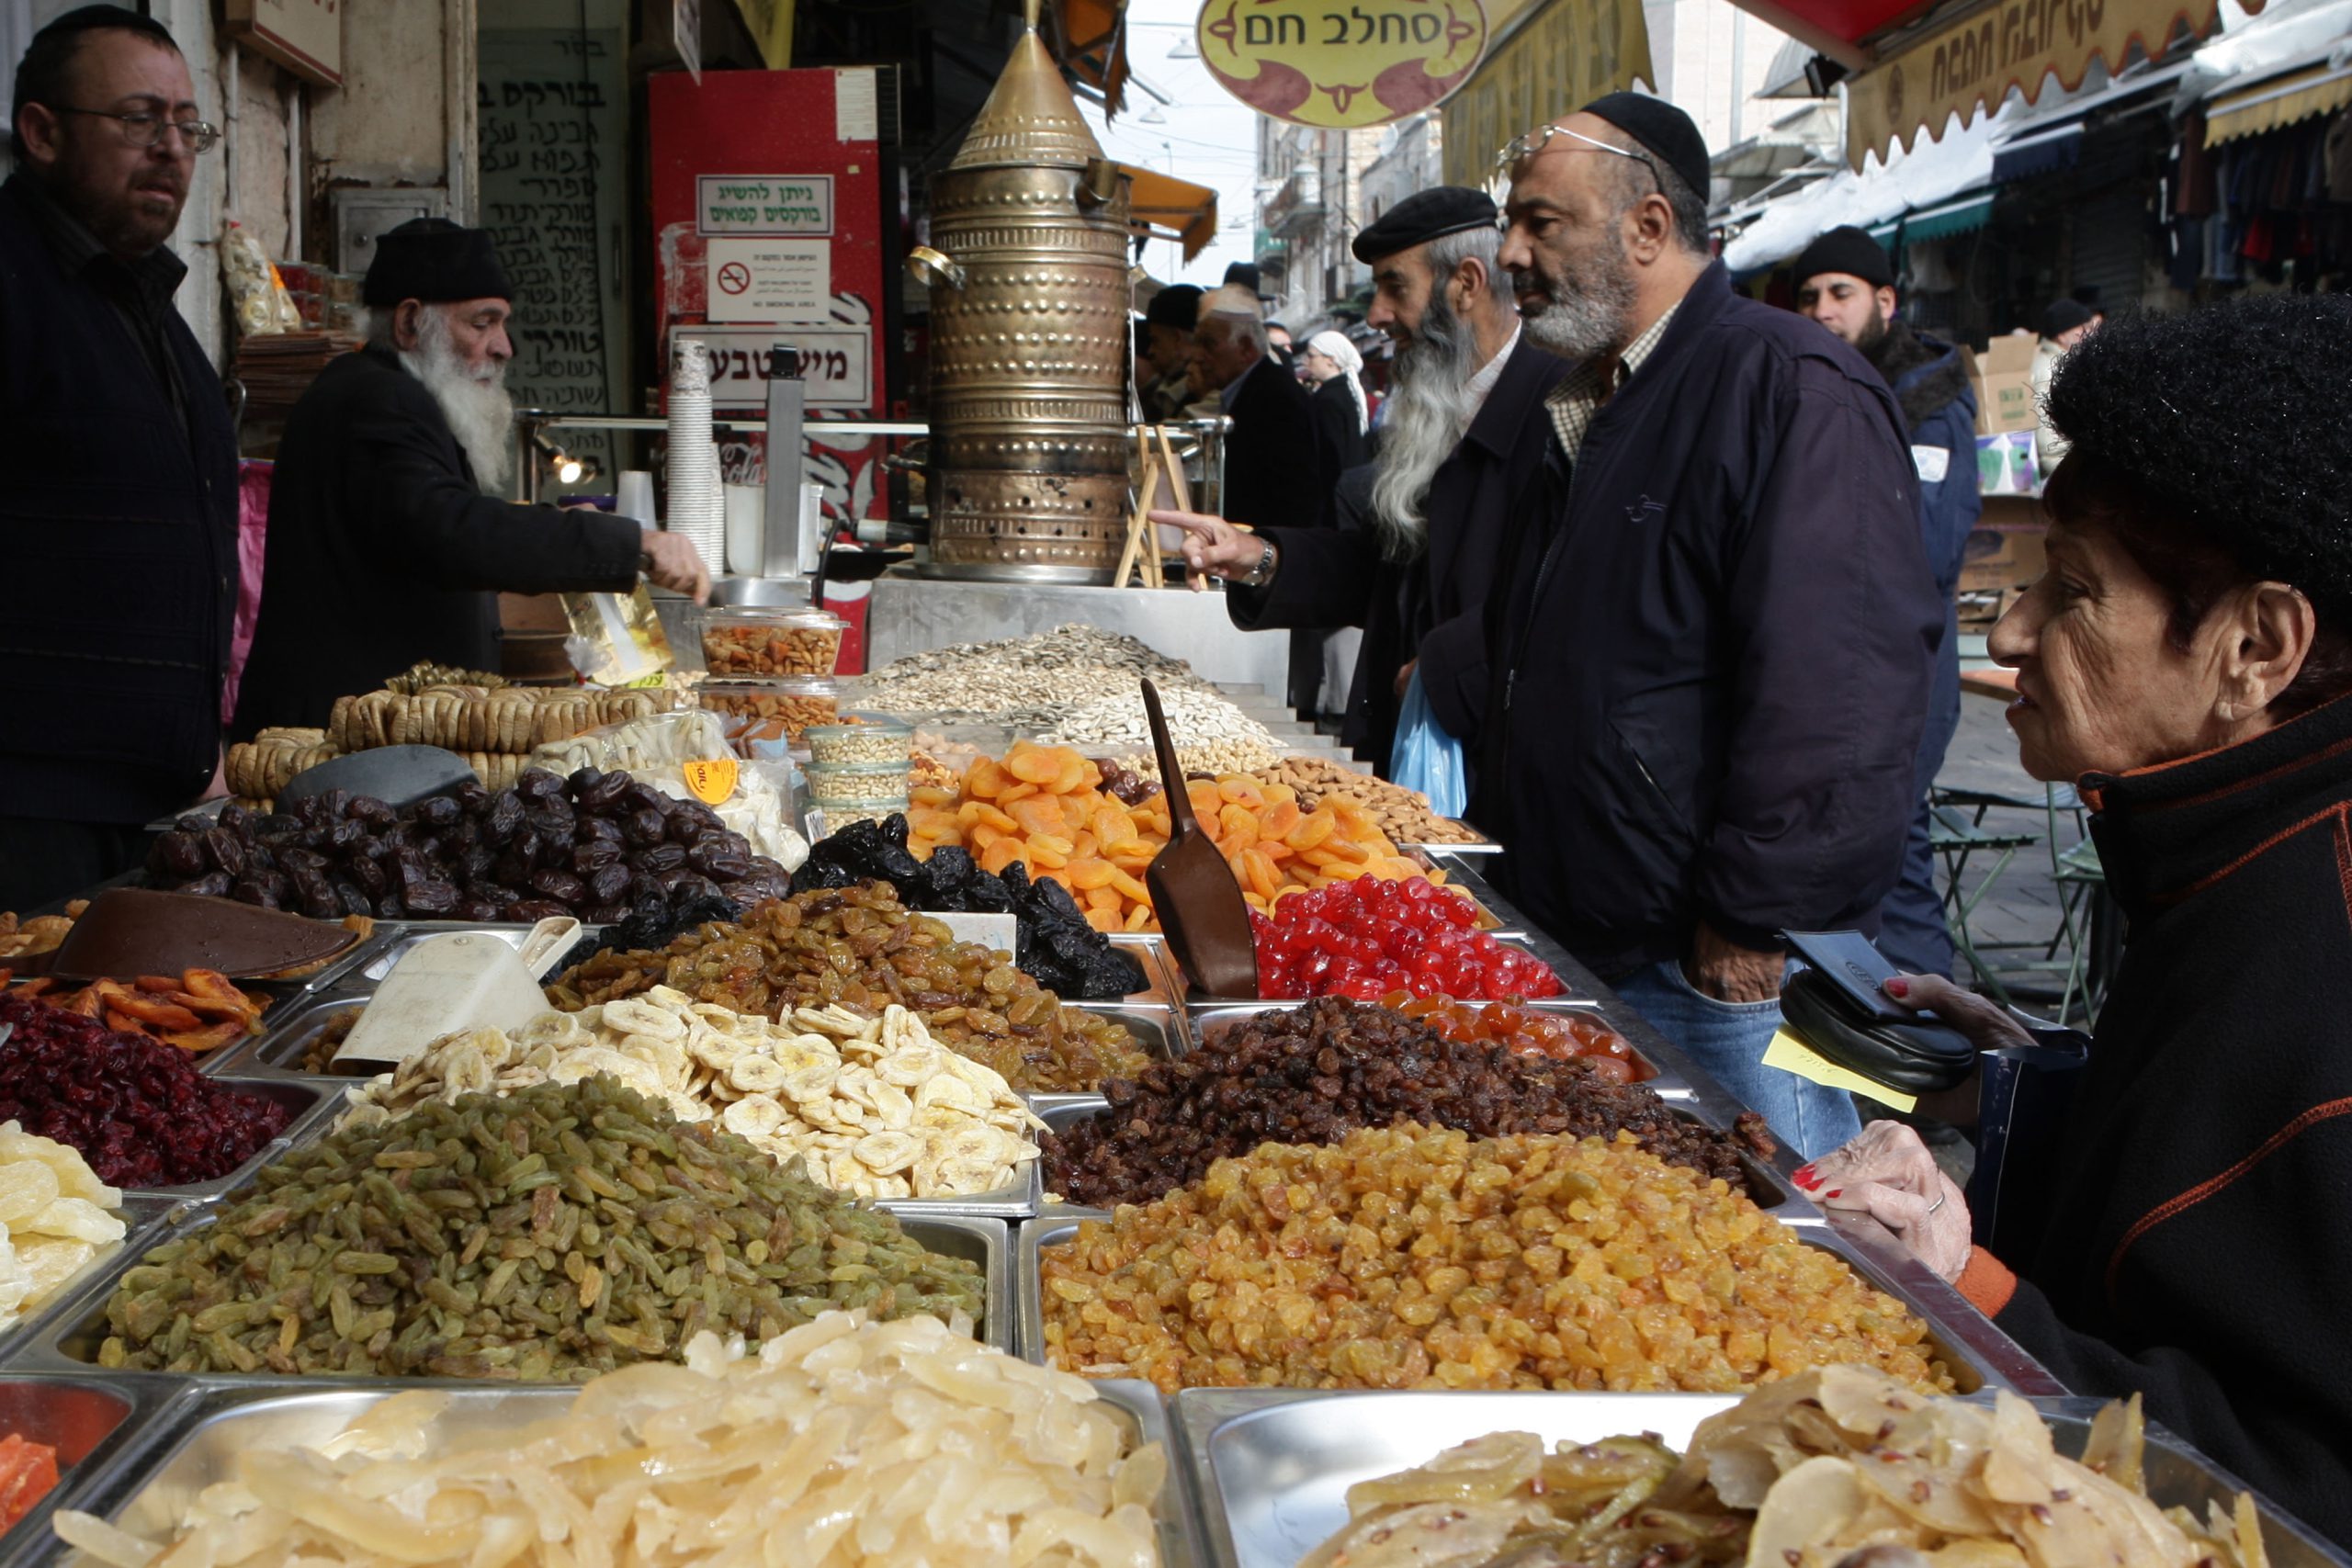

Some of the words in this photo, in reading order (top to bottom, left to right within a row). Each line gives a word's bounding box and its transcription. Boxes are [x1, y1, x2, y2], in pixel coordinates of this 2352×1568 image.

[1244, 13, 1306, 45] חם
[1321, 6, 1442, 45] סחלב
[717, 181, 771, 201] להשיג
[778, 186, 814, 205] ניתן
[708, 206, 759, 226] קפואים
[762, 206, 822, 226] בורקסים
